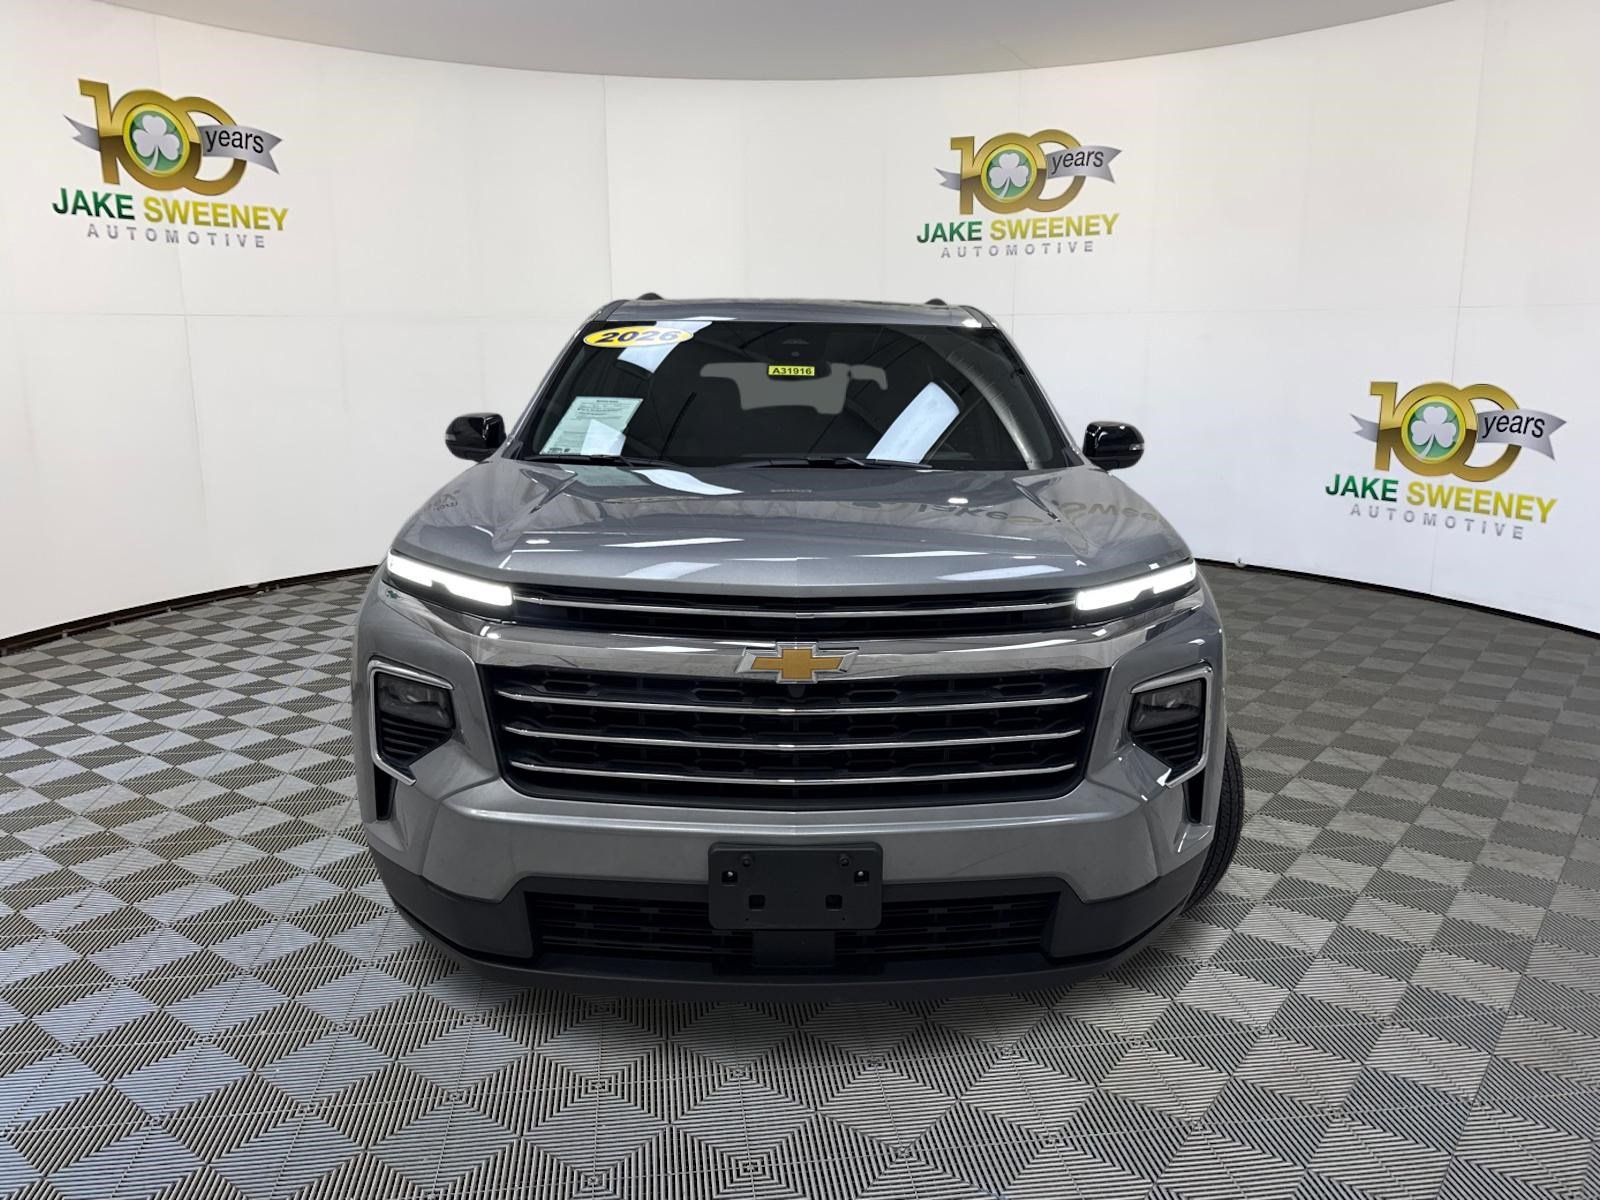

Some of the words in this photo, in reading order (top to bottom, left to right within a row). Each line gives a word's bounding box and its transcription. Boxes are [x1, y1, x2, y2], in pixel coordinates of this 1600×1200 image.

[78, 79, 247, 196] 100
[205, 129, 265, 154] years
[950, 128, 1087, 215] 100
[1050, 149, 1105, 175] years
[52, 187, 136, 221] JAKE
[143, 196, 289, 231] SWEENEY
[916, 220, 983, 244] JAKE
[989, 212, 1121, 241] SWEENEY
[87, 223, 266, 249] AUTOMOTIVE
[940, 240, 1094, 259] AUTOMOTIVE
[594, 330, 682, 344] 2026
[772, 367, 813, 375] A31916
[1370, 381, 1522, 483] 100
[1481, 413, 1546, 439] years
[1325, 473, 1399, 503] JAKE
[1405, 480, 1558, 524] SWEENEY
[1350, 502, 1525, 541] AUTOMOTIVE
